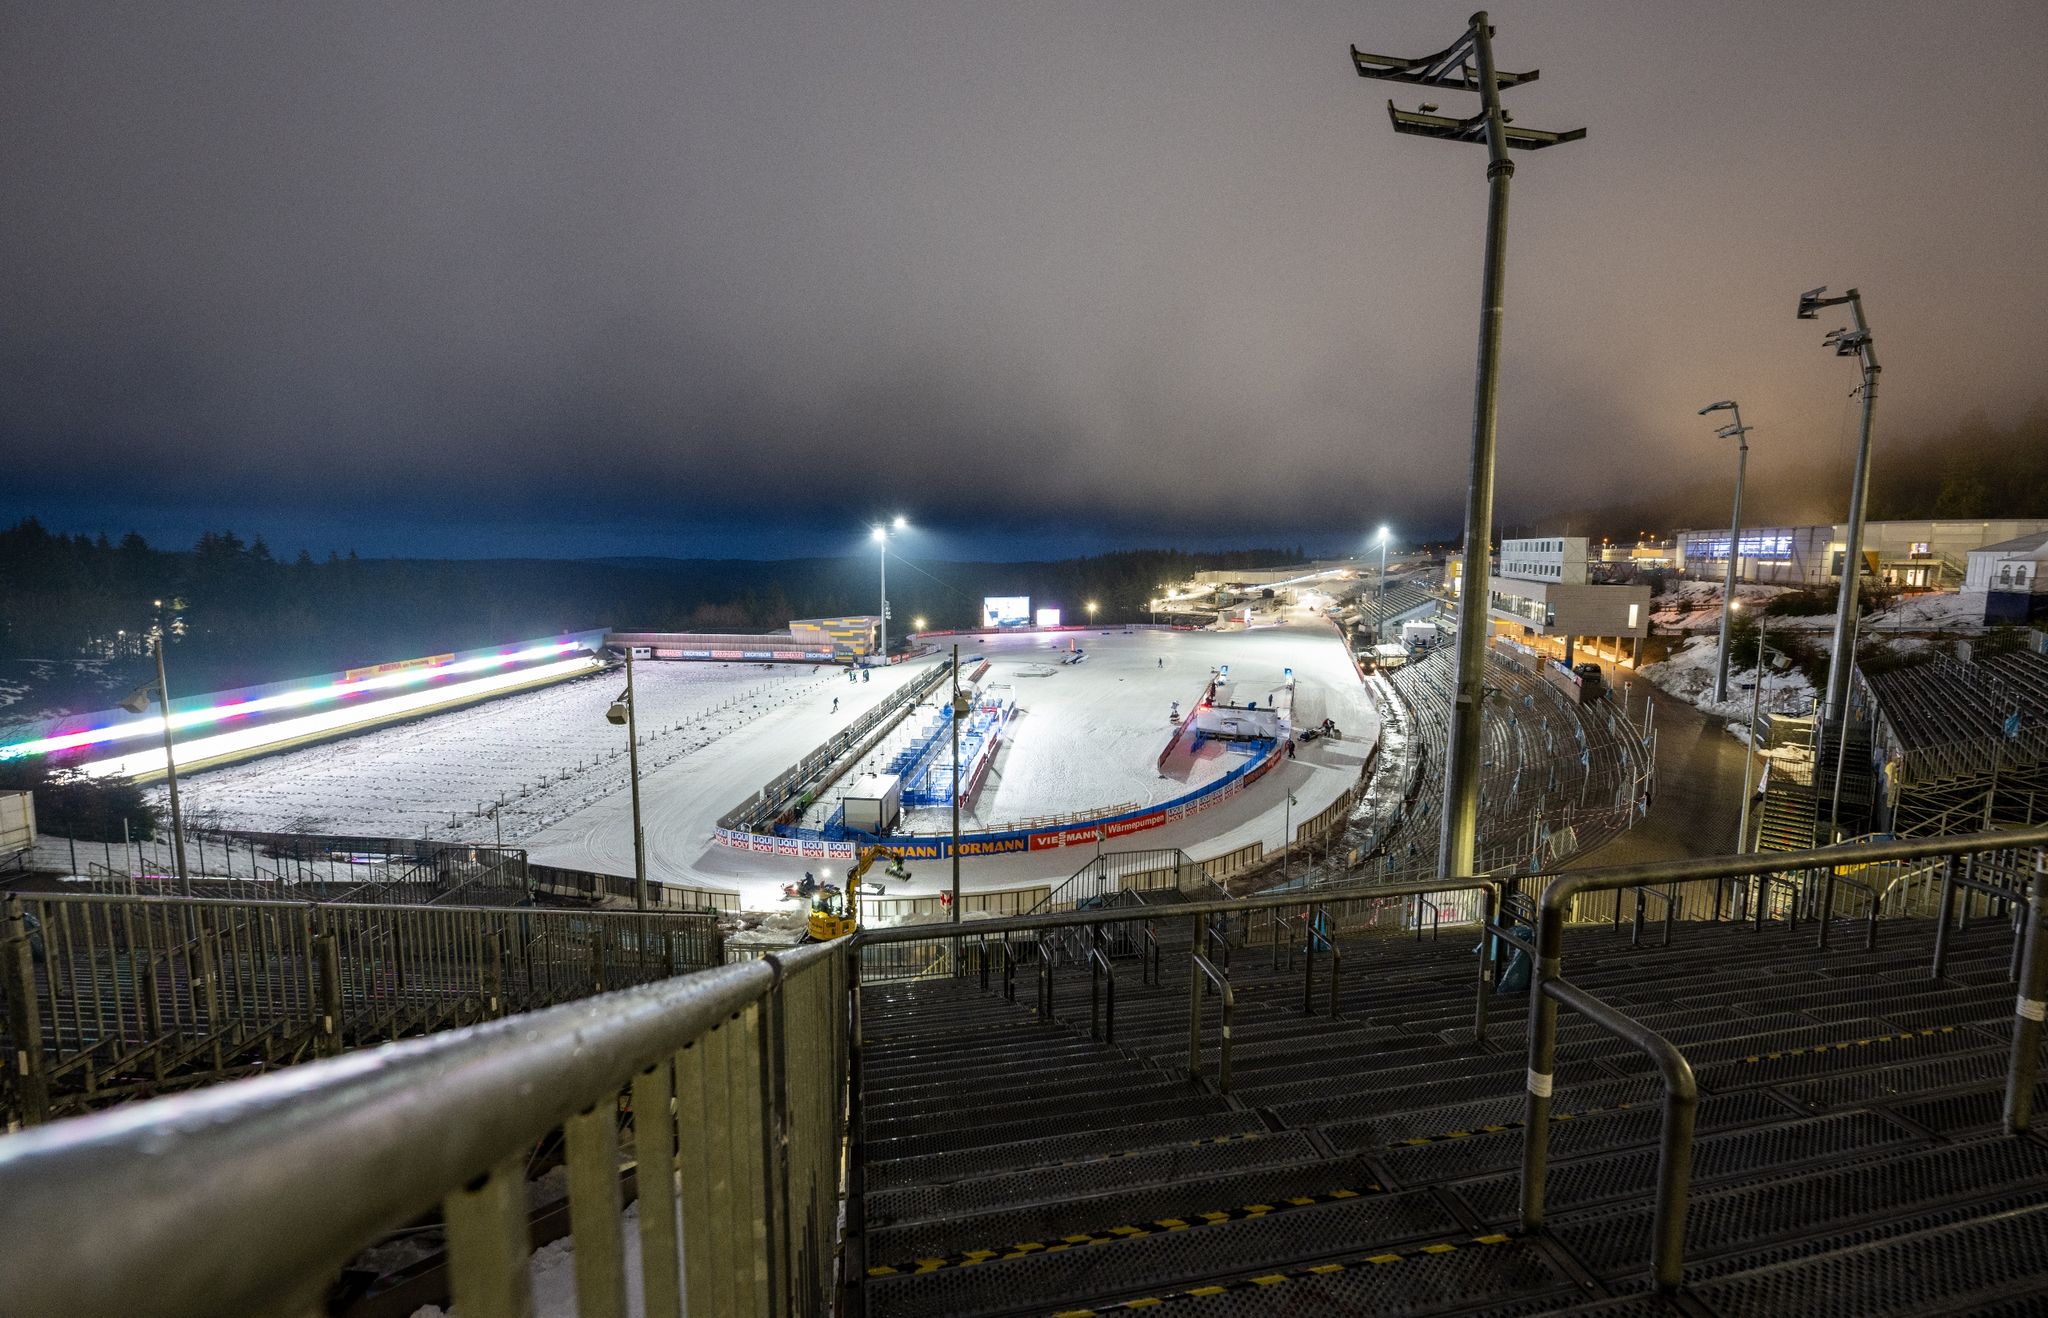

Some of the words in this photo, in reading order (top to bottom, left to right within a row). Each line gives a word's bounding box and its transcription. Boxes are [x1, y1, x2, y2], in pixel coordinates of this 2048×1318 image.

[1108, 814, 1165, 834] Wärmepumpen
[731, 832, 749, 842] LIQUI
[753, 835, 773, 845] LIQUI
[731, 839, 749, 849] MOLY
[778, 838, 798, 847] LIQUI
[803, 841, 823, 850] LIQUI
[828, 842, 850, 850] LIQUI
[753, 843, 773, 853] MOLY
[778, 846, 798, 855] MOLY
[803, 849, 823, 857] MOLY
[829, 850, 852, 858] MOLY
